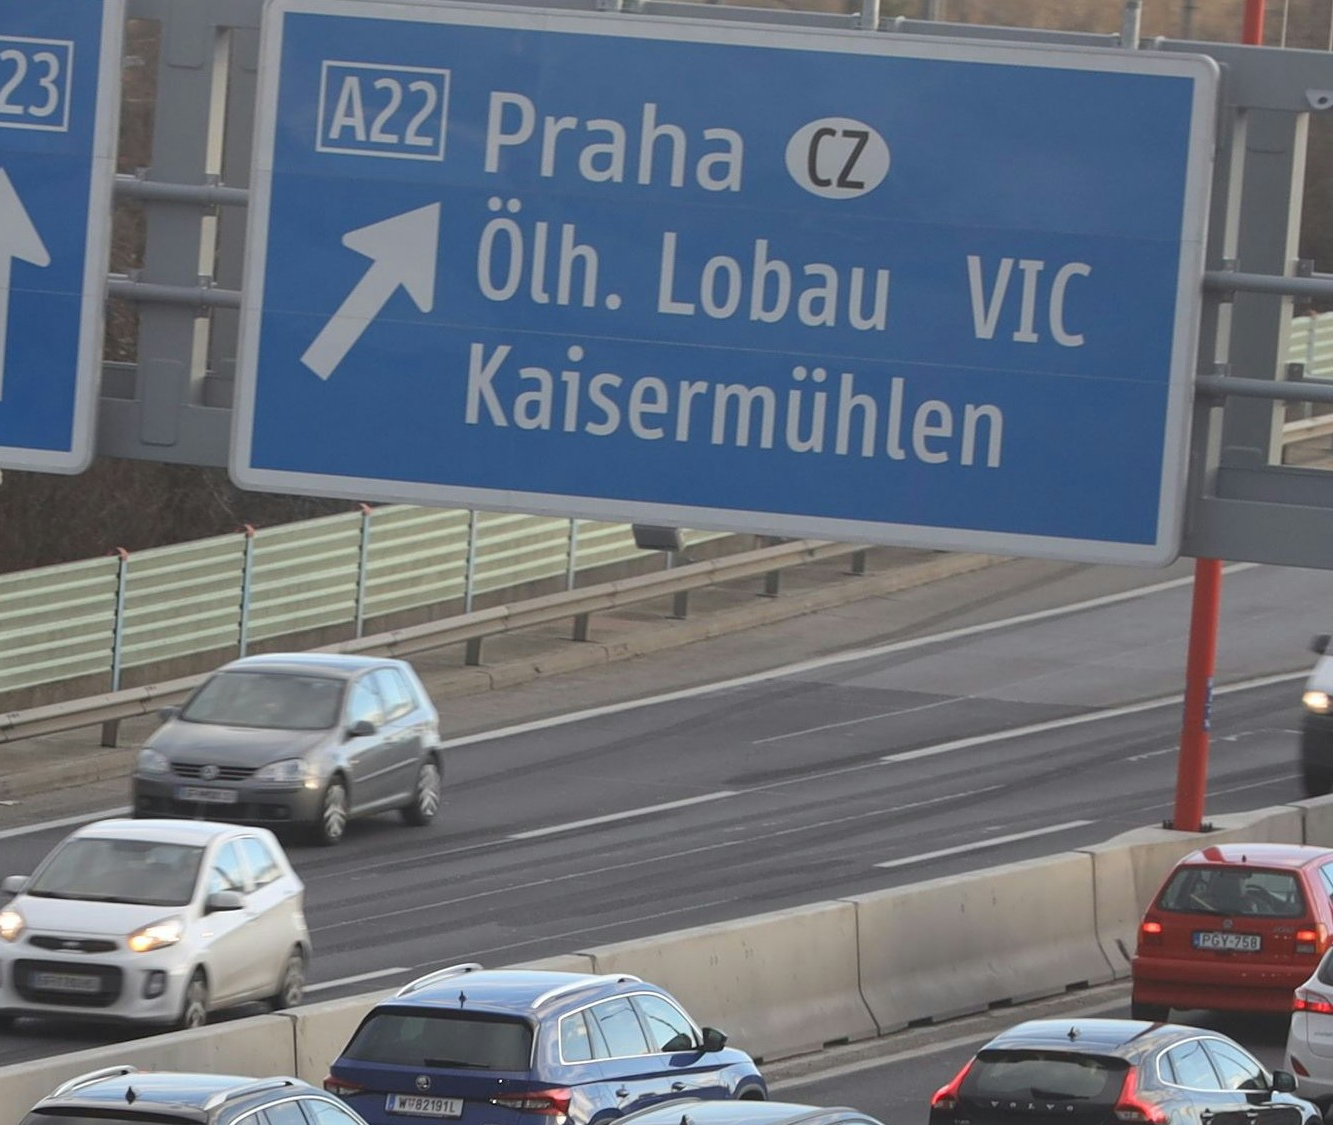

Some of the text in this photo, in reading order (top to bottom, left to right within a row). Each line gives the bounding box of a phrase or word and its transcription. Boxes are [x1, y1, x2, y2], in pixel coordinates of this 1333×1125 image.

[329, 76, 436, 146] A22
[485, 91, 870, 191] Praha CZ
[479, 197, 1090, 346] Ölh. Lobau VIC
[467, 343, 1002, 466] Kaisermühlen
[990, 1100, 1074, 1112] VOLVO
